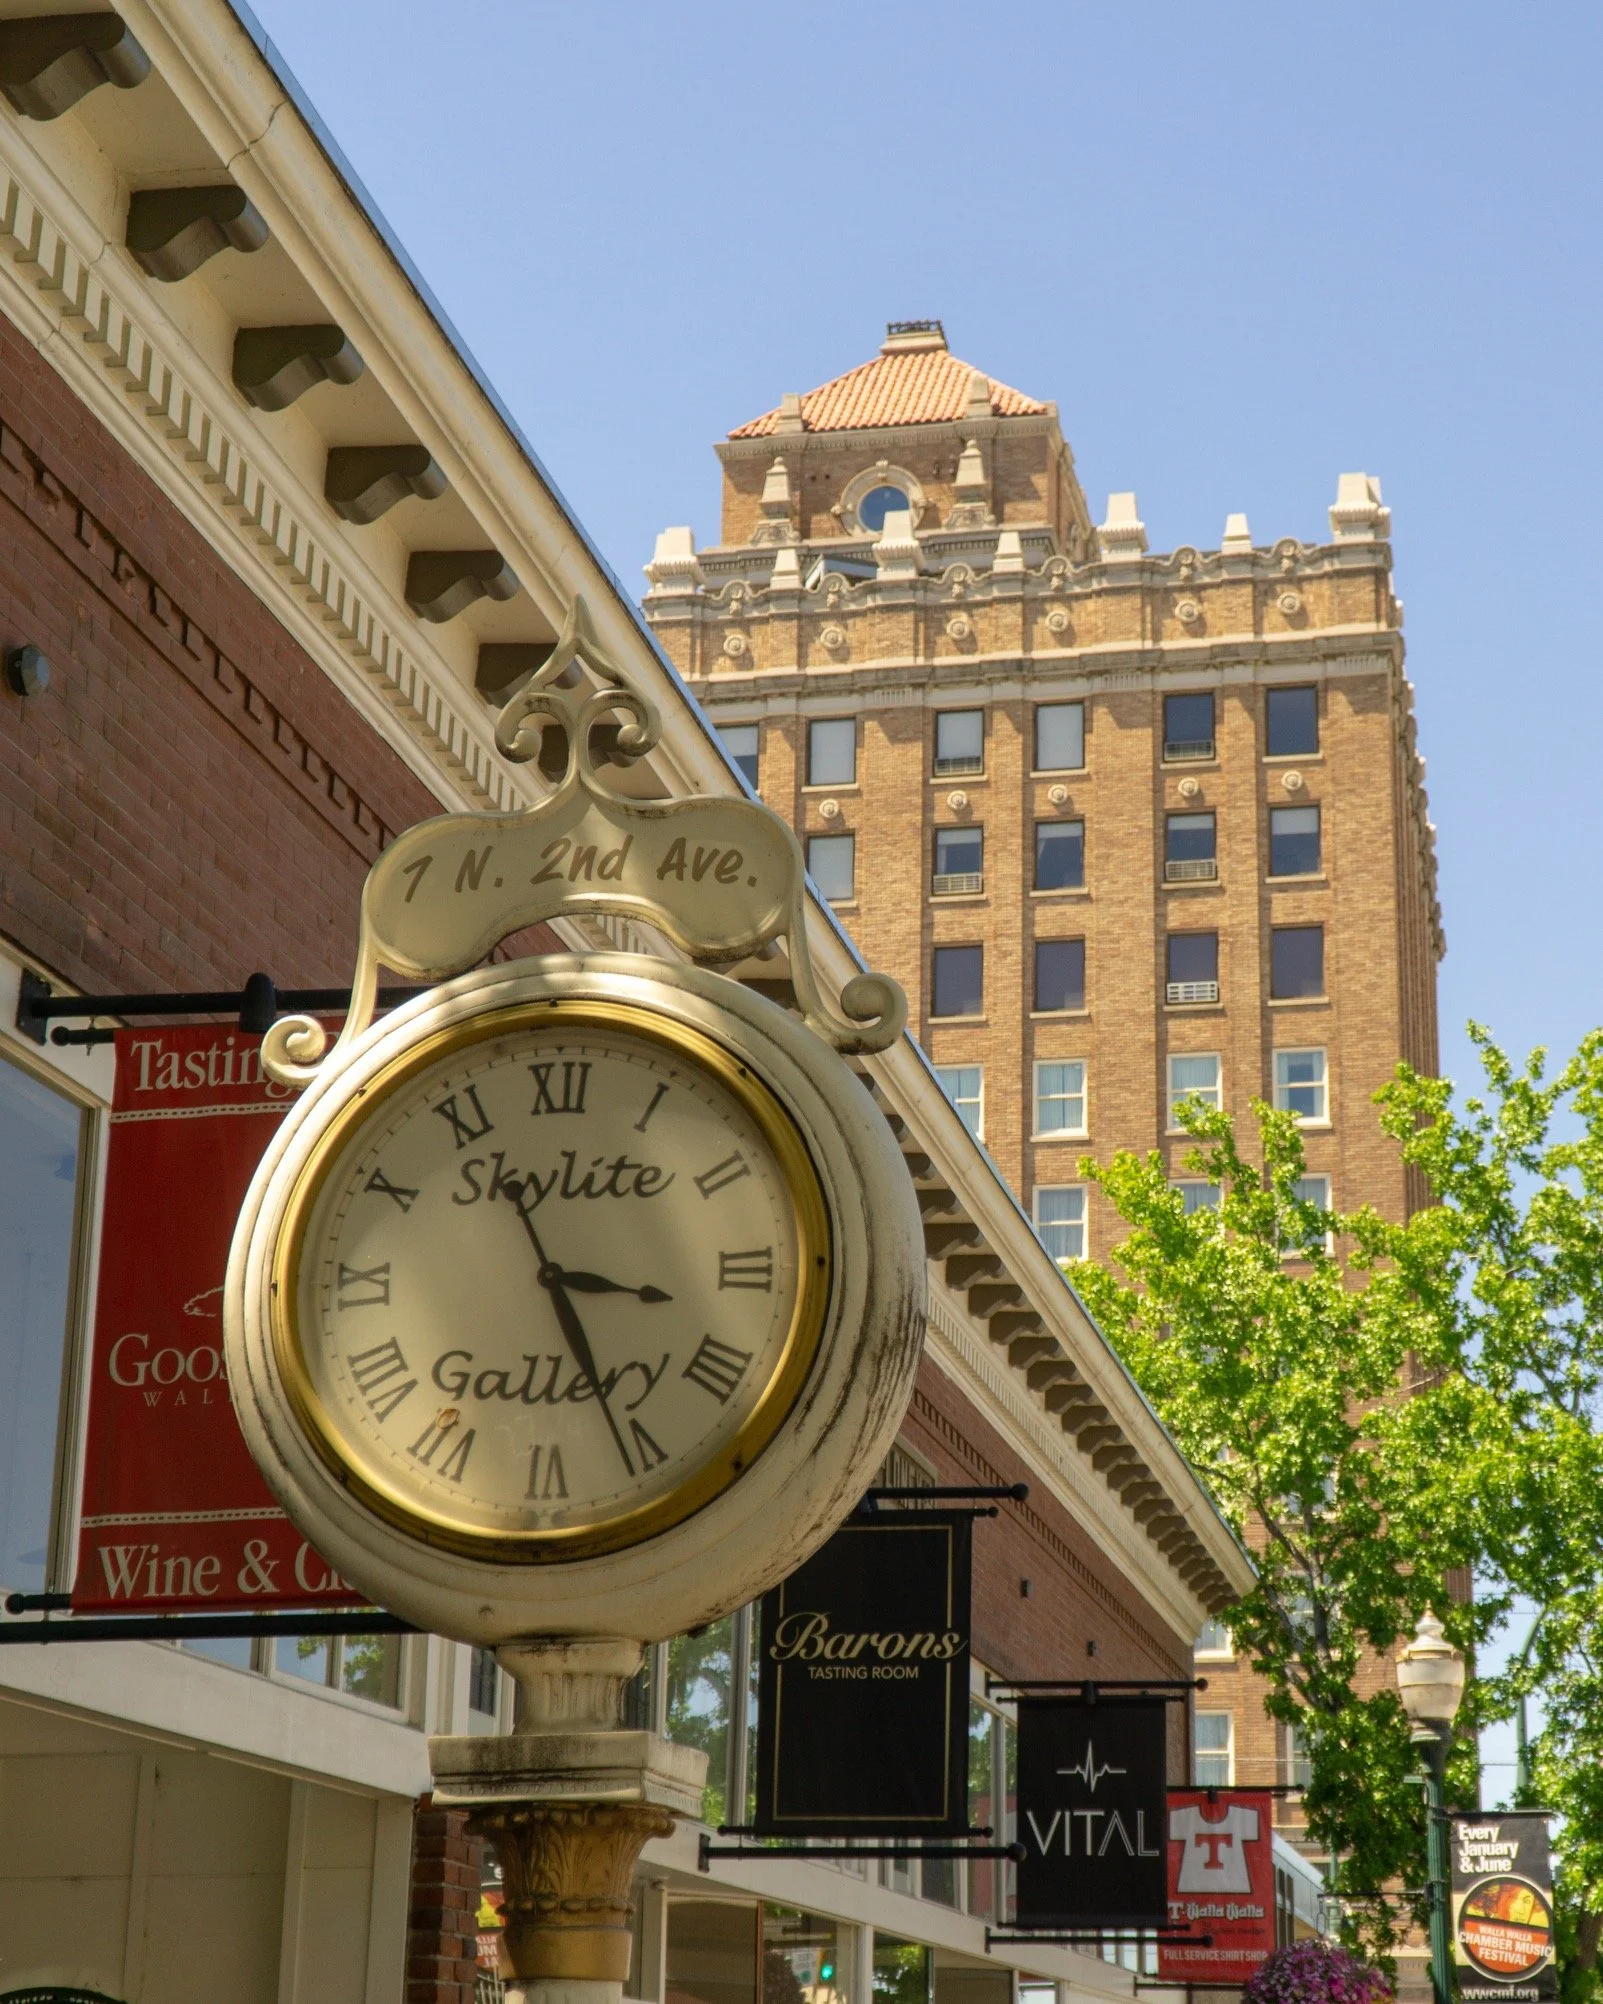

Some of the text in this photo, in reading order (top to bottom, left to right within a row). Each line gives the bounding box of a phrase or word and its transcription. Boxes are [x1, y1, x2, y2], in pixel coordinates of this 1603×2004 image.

[454, 845, 504, 893] N.
[529, 834, 634, 885] 2nd
[656, 836, 757, 888] Ave.
[451, 1150, 677, 1216] Skylite
[430, 1349, 671, 1412] Gallery
[97, 1543, 222, 1600] Wine
[237, 1539, 281, 1594] &
[769, 1611, 969, 1661] Barons
[808, 1665, 919, 1680] TASTING ROOM
[1026, 1809, 1160, 1857] VITAL
[1458, 1822, 1500, 1843] Every
[1458, 1839, 1519, 1859] January
[1459, 1855, 1513, 1873] & June
[1459, 1931, 1554, 1957] CHAMBER MUSIC
[1479, 1924, 1533, 1942] WALLA WALLA
[1163, 1949, 1184, 1960] FULL
[1184, 1949, 1219, 1960] SERVICE
[1219, 1949, 1244, 1961] SHIRT
[1479, 1946, 1529, 1966] FESTIVAL
